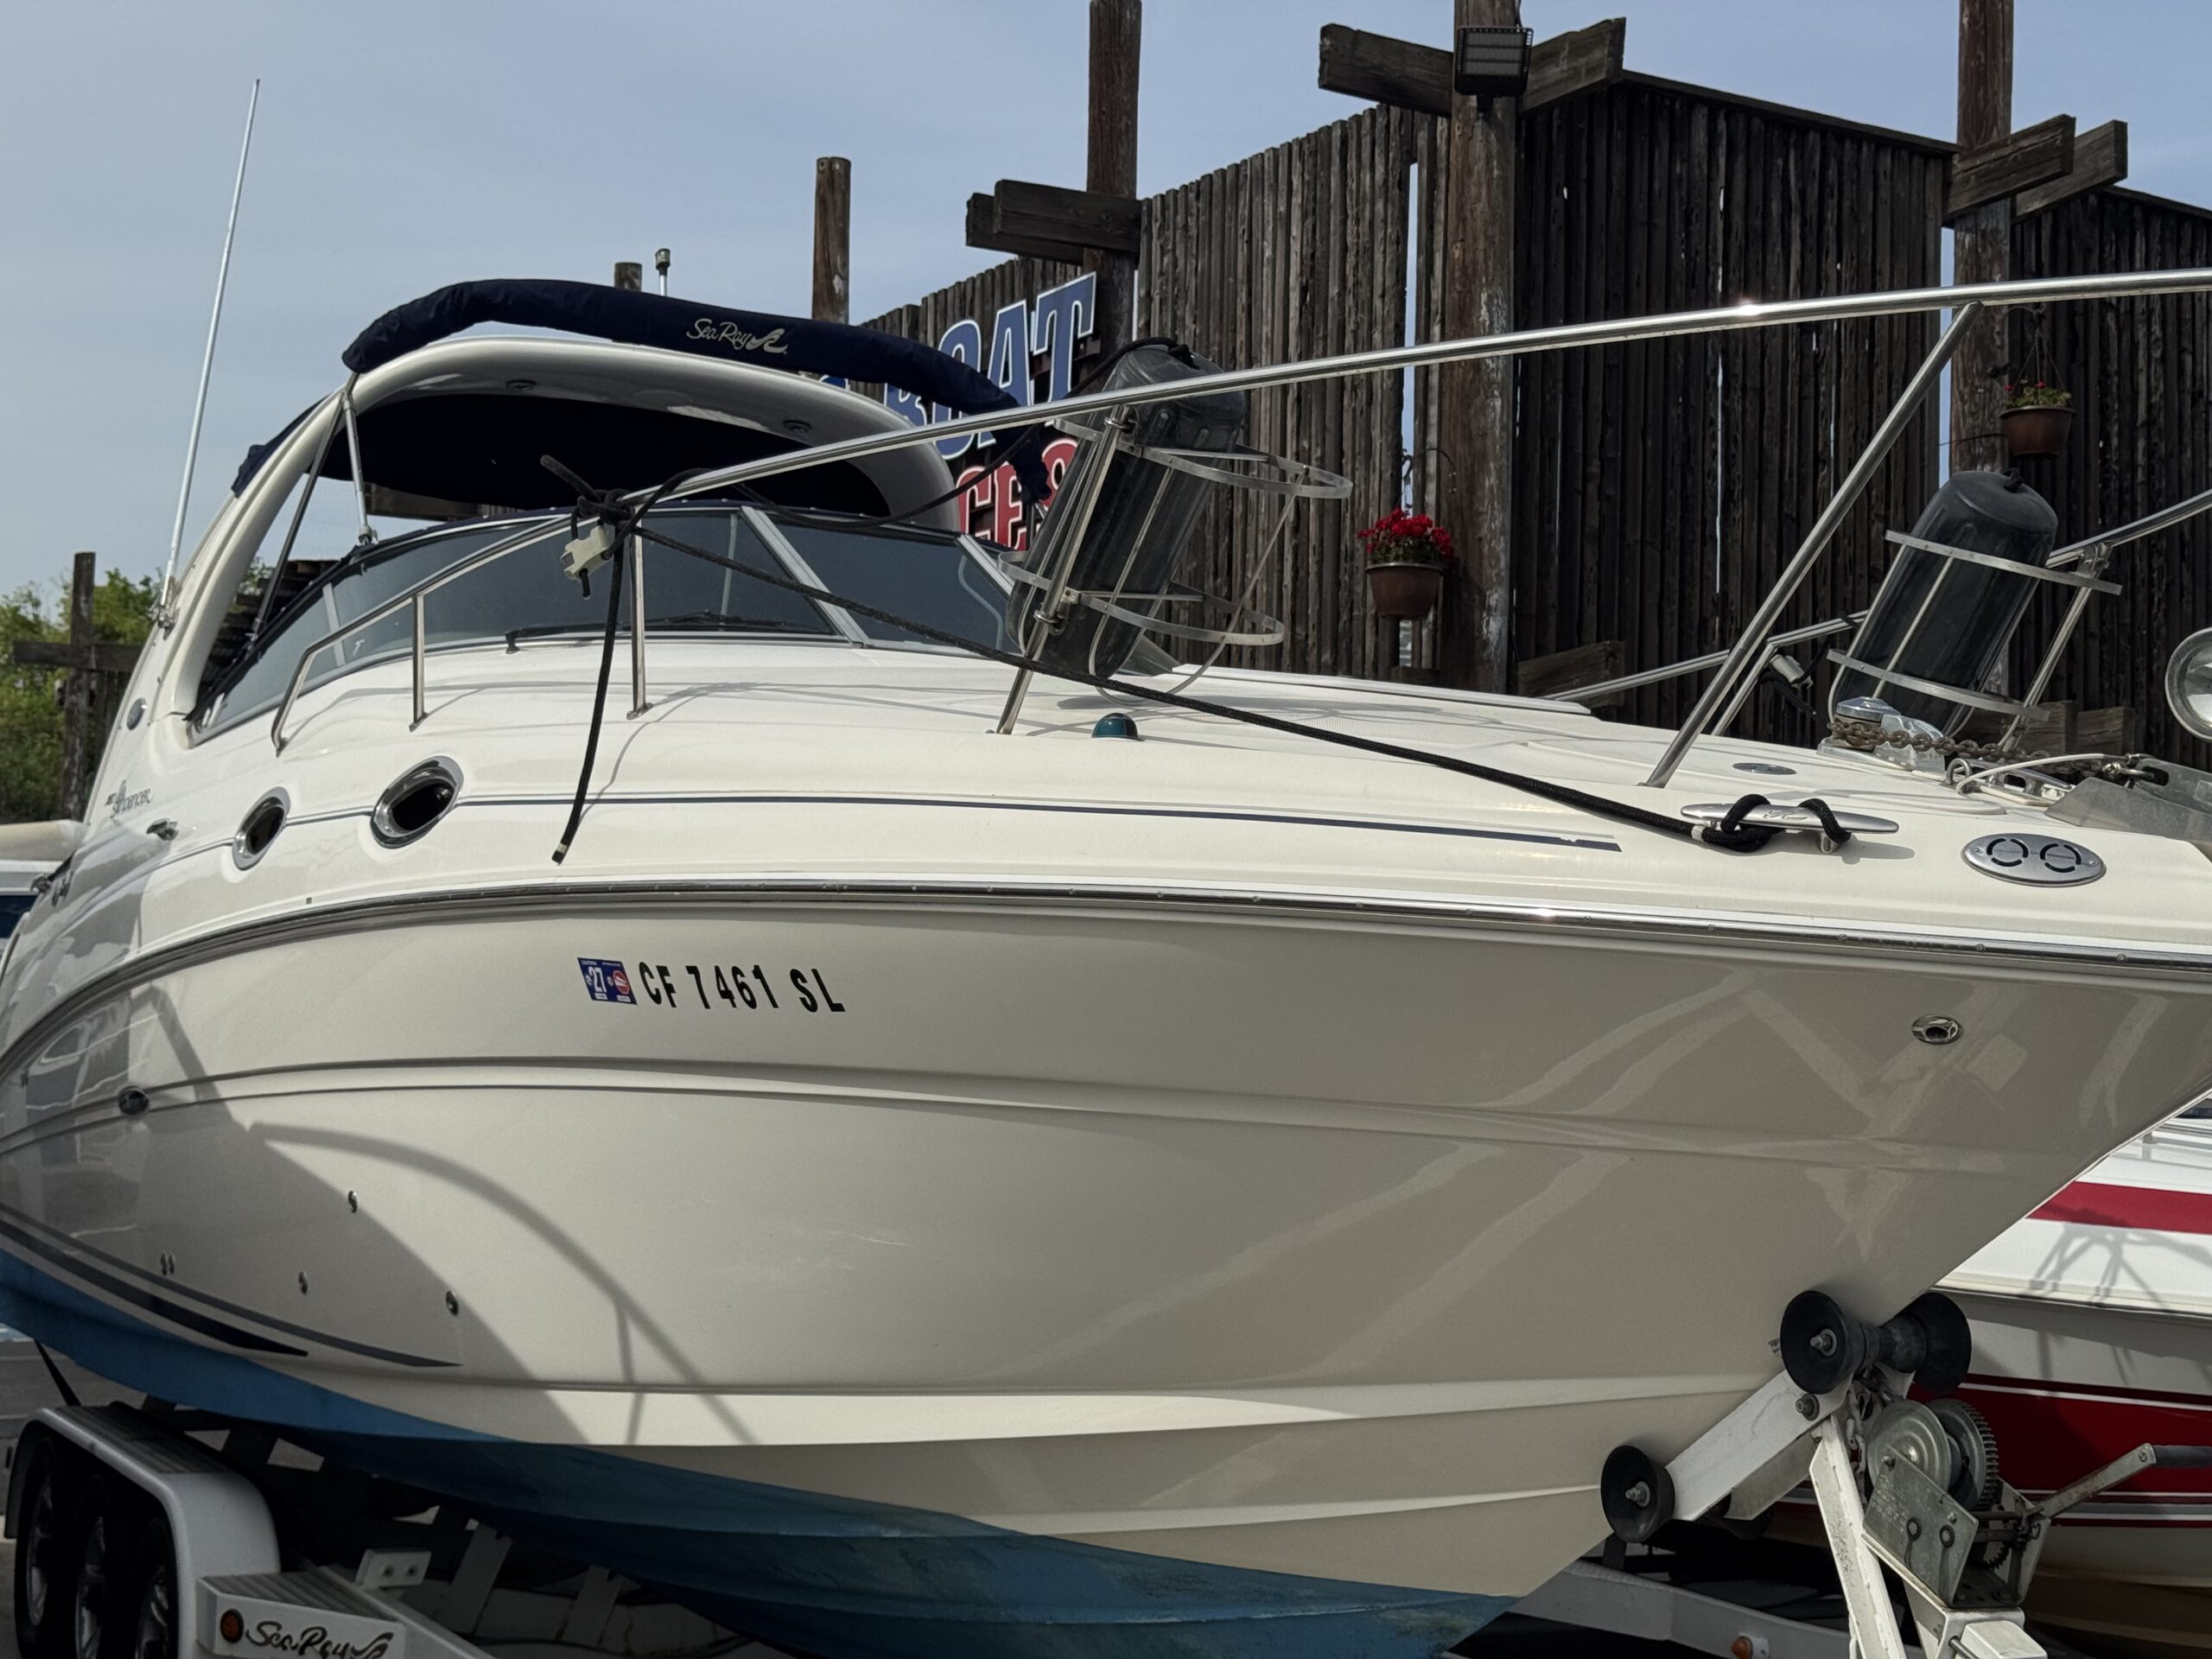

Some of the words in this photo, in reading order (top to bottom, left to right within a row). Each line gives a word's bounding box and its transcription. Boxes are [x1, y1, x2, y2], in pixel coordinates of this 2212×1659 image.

[588, 966, 607, 993] 27
[639, 961, 677, 1007] CF
[685, 964, 779, 1009] 7461
[789, 968, 846, 1013] SL
